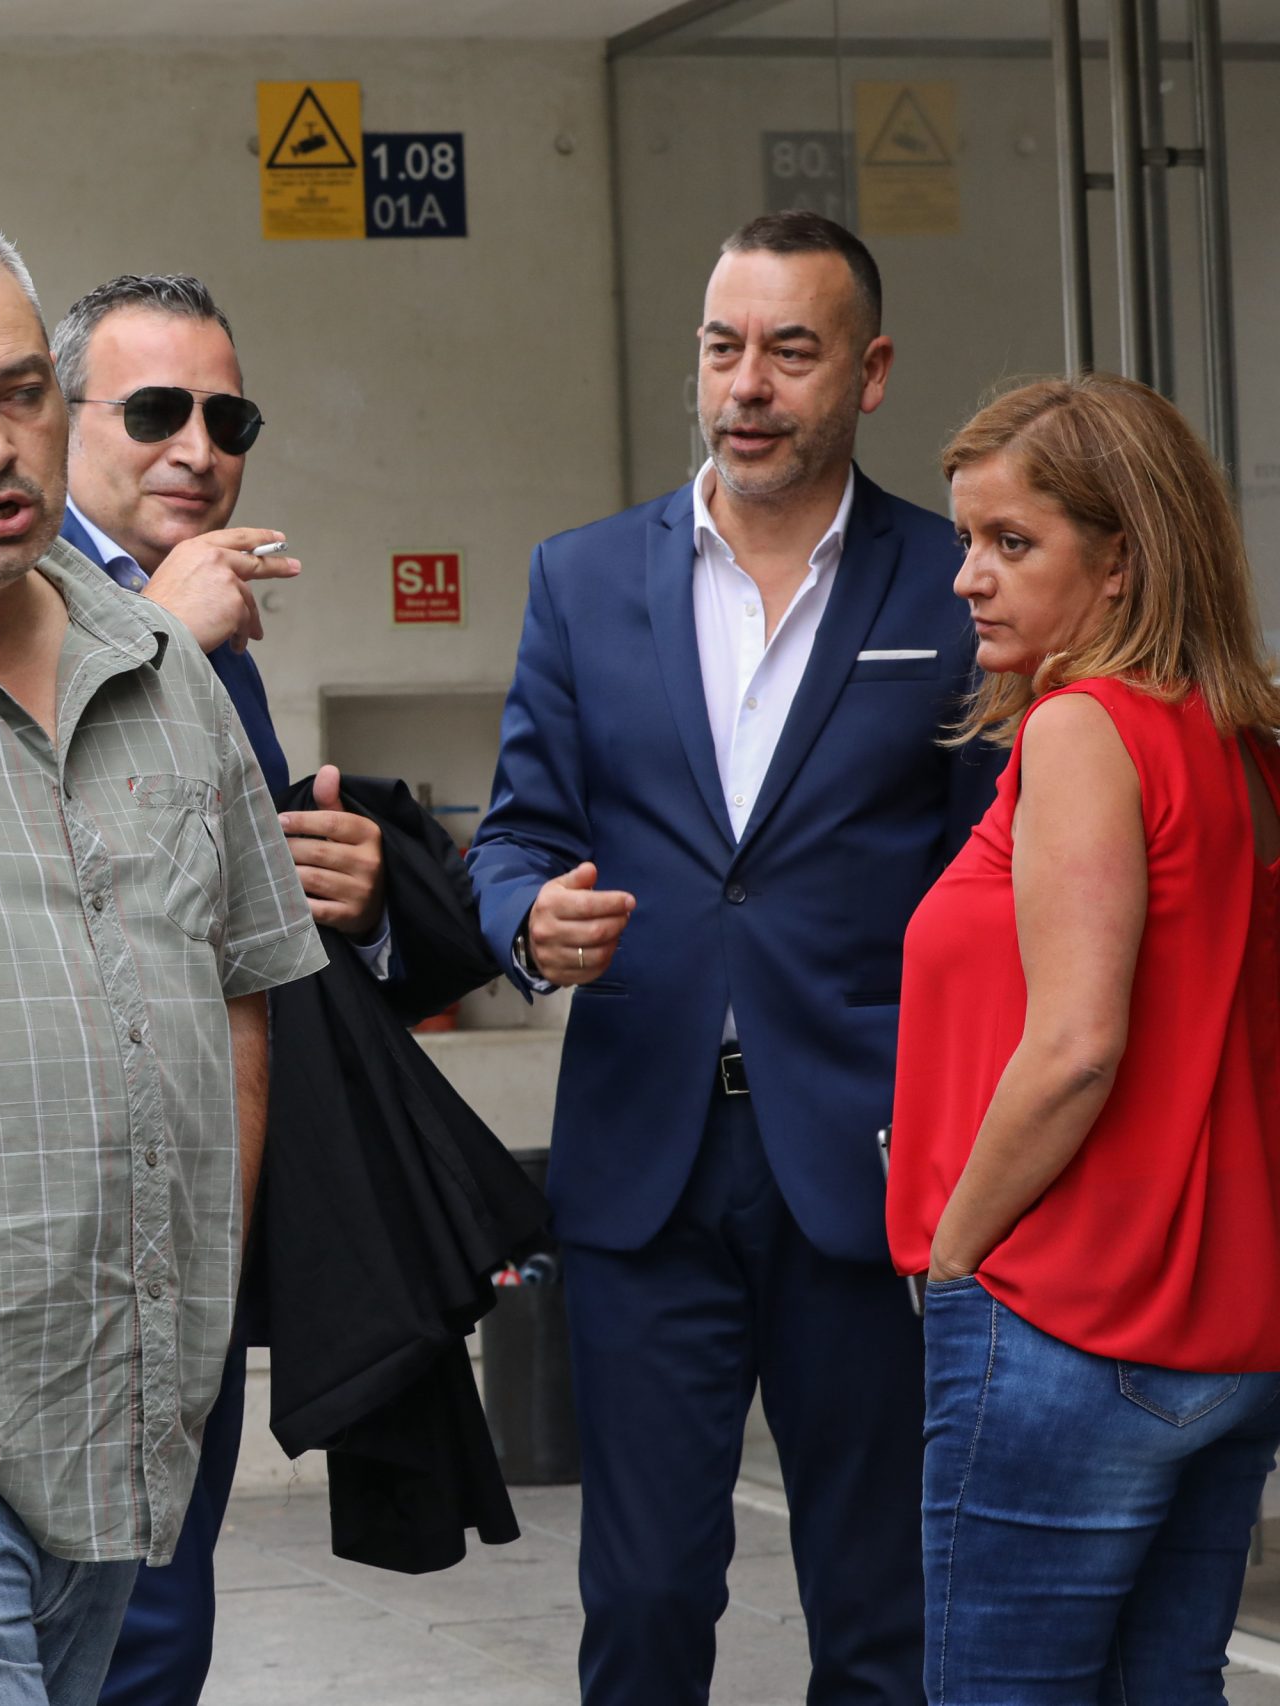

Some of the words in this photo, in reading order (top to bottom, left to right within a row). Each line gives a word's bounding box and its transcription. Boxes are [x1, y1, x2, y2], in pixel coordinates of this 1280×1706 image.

[371, 142, 456, 180] 1.08
[372, 193, 448, 230] 01.A
[397, 560, 456, 594] S.I.
